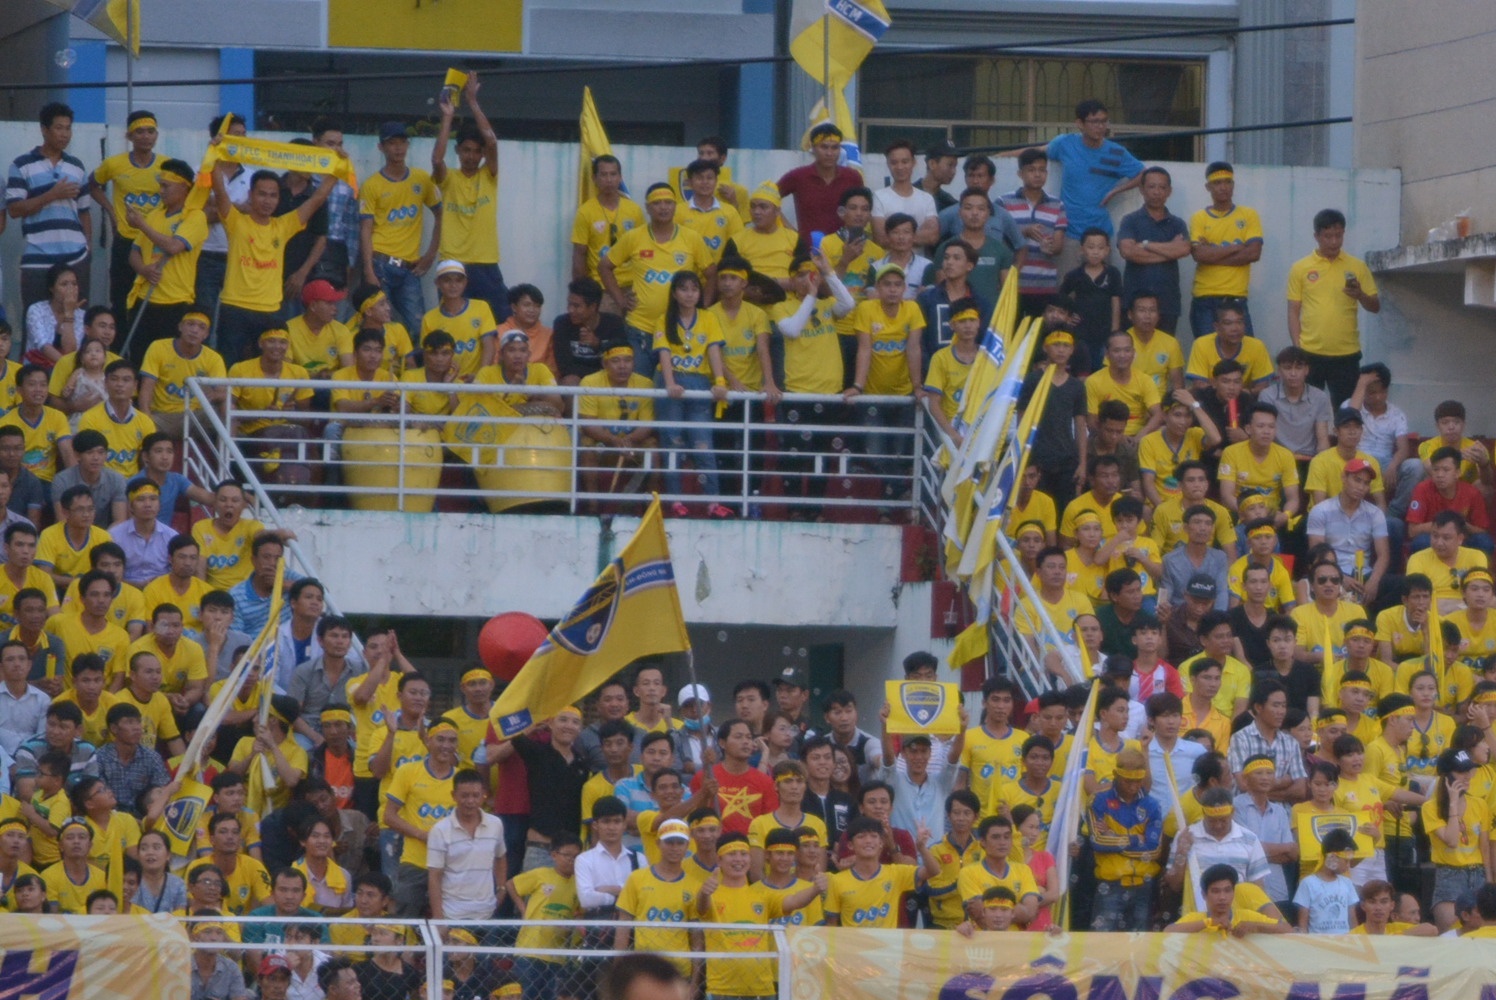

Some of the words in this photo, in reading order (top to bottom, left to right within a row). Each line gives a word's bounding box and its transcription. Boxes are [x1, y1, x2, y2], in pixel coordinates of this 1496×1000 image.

[980, 765, 1017, 780] FC
[646, 906, 685, 922] FLC
[853, 904, 890, 923] FLC
